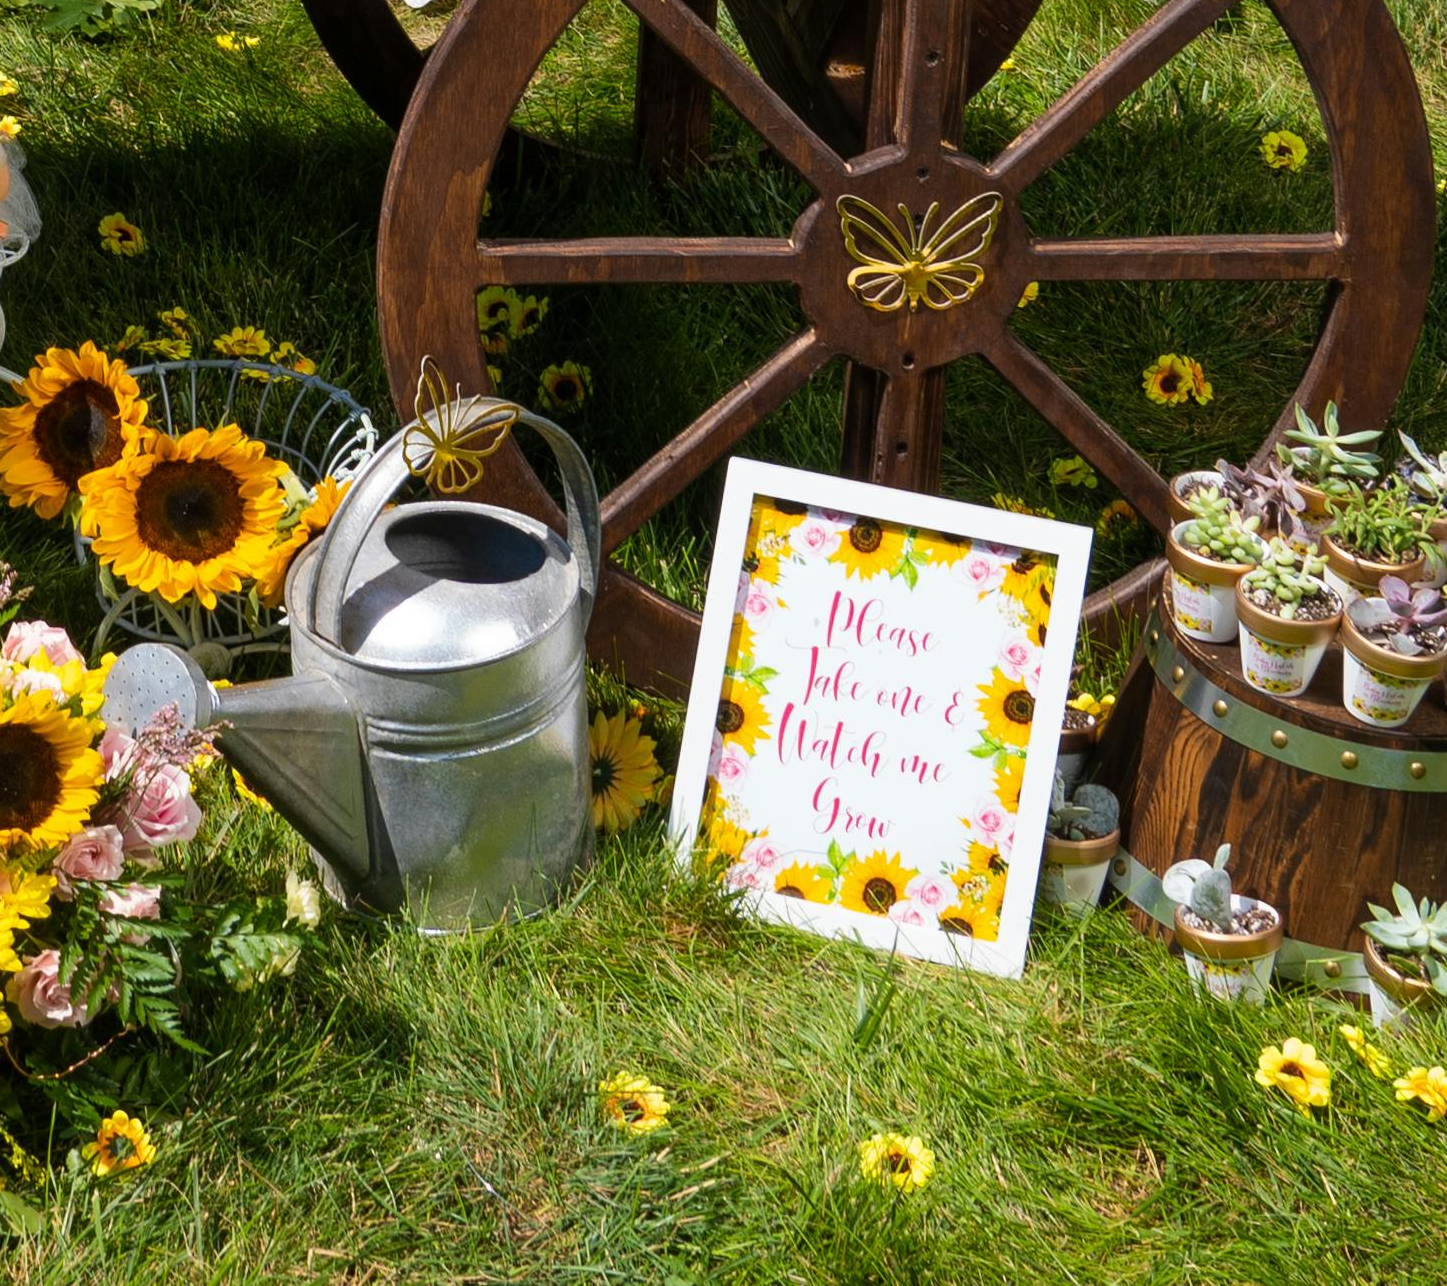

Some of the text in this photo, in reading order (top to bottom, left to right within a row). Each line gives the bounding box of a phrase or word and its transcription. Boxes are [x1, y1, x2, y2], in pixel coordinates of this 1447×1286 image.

[826, 590, 943, 658] Please
[785, 638, 965, 731] Take one &
[777, 701, 953, 785] Watch me
[812, 776, 897, 840] Grow
